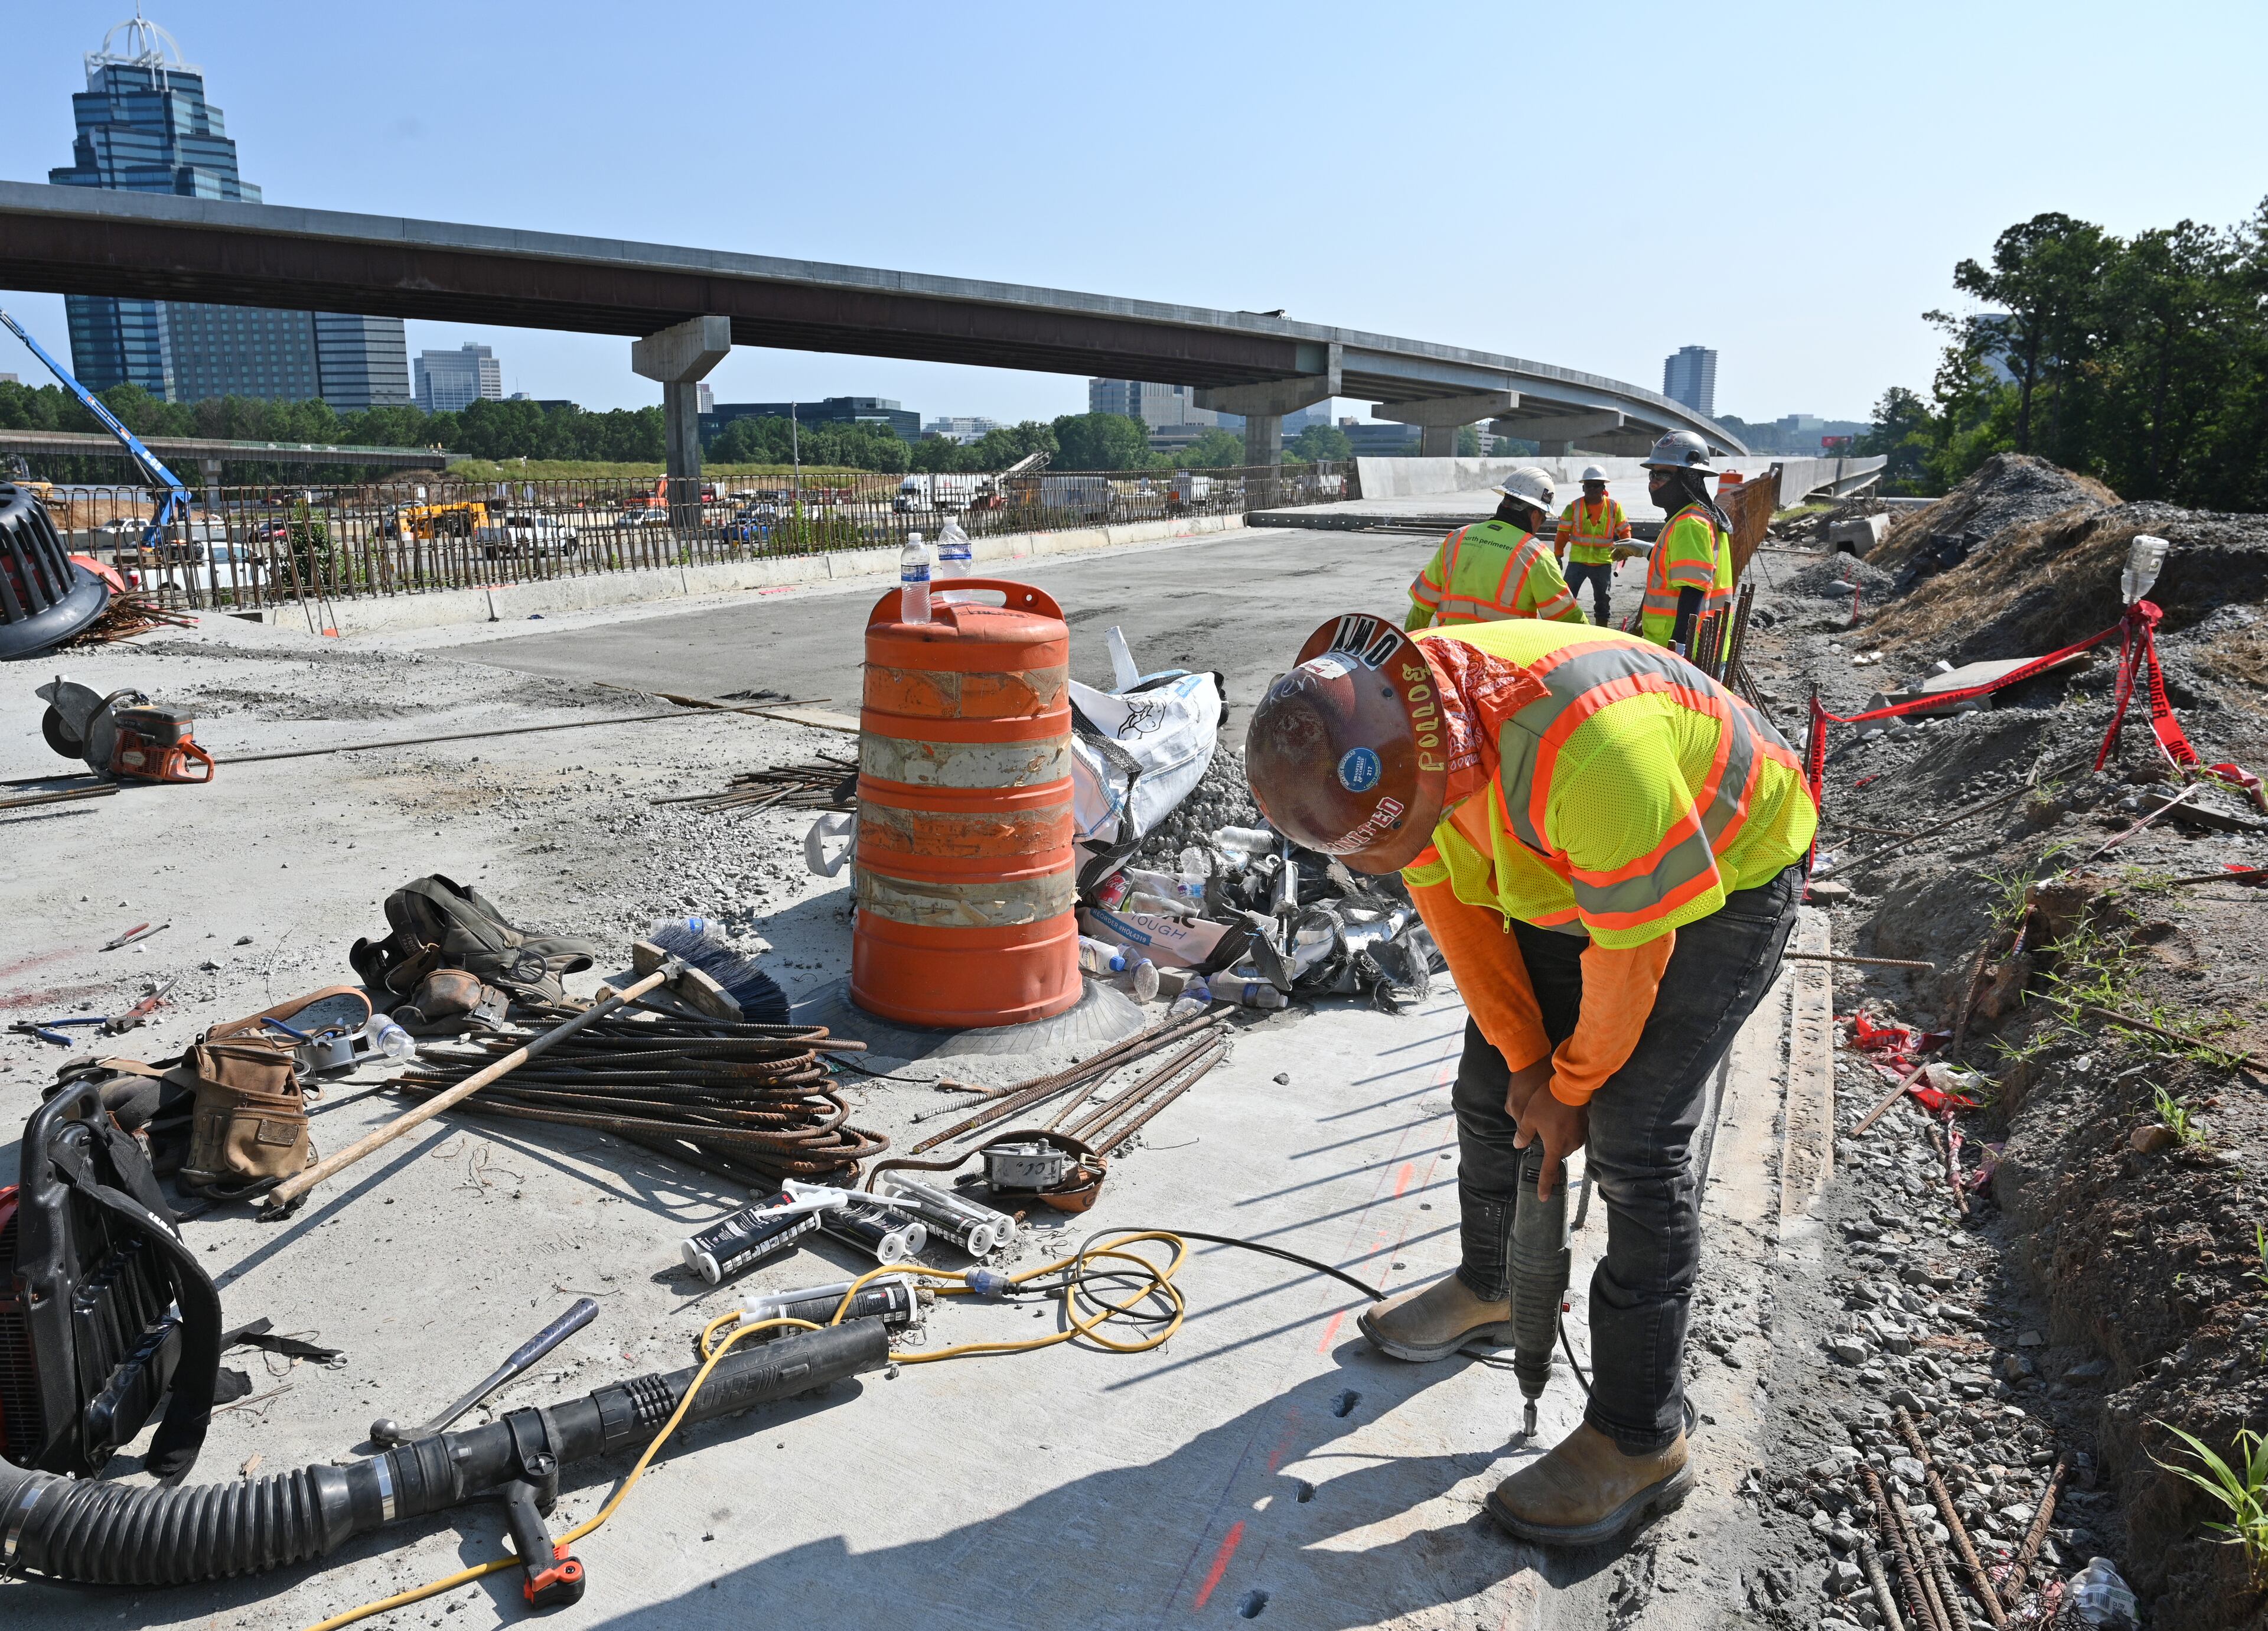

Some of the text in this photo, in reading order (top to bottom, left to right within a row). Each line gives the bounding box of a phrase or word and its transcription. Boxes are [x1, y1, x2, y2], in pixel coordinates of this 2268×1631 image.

[142, 451, 162, 471] S-65
[1479, 539, 1513, 551] perimeter
[2148, 663, 2168, 719] DANGER
[1340, 751, 1355, 786] HEARTIS BUCKHEAD
[1106, 874, 1130, 893] Cola
[1093, 909, 1146, 943] REORDER #HOL4319
